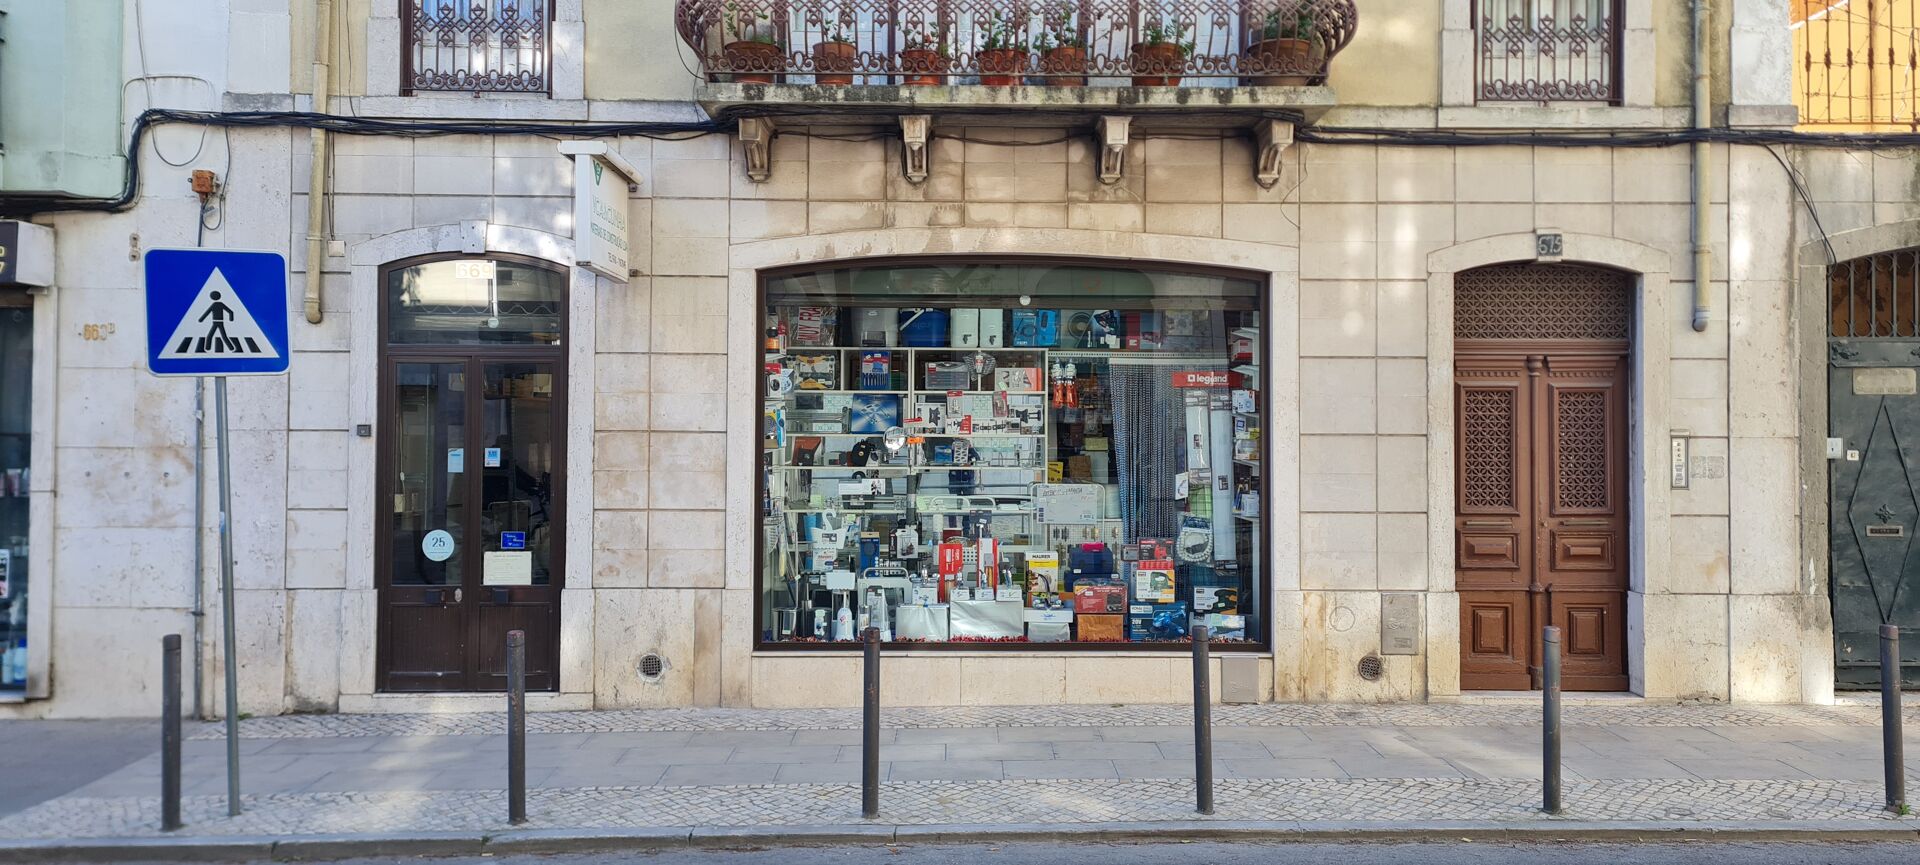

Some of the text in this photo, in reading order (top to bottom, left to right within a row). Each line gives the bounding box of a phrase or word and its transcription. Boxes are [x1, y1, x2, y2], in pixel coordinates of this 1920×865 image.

[1538, 235, 1562, 254] 675
[457, 263, 492, 278] 669
[432, 536, 446, 548] 25
